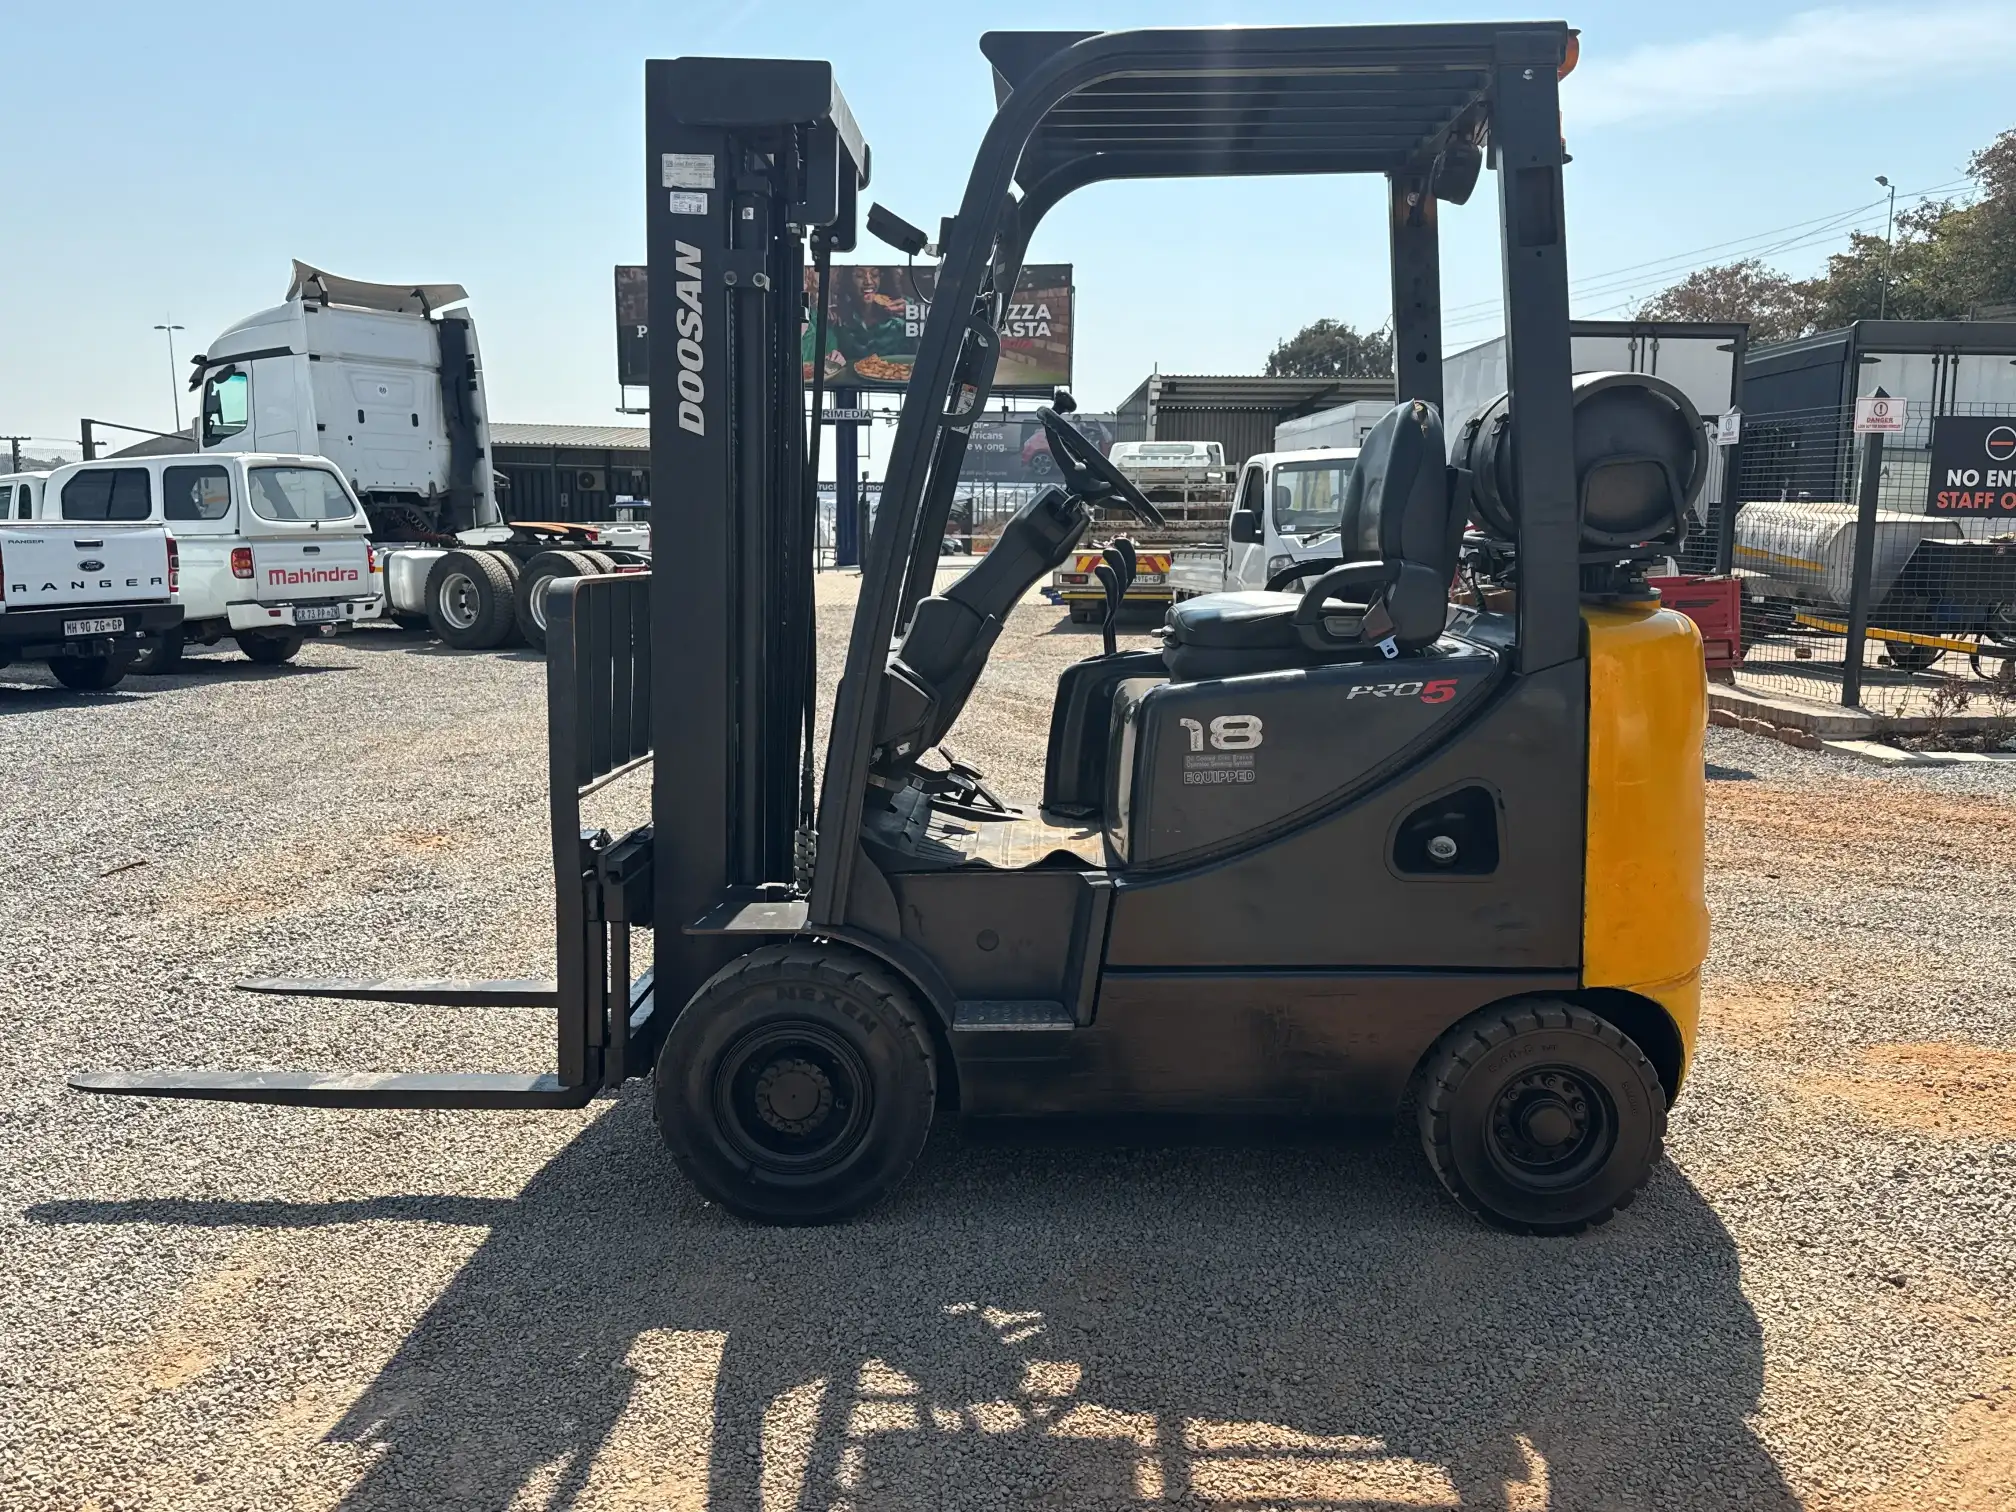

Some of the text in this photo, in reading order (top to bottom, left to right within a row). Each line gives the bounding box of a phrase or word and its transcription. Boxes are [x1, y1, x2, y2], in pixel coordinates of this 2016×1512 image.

[905, 304, 1052, 321] BI ZZA
[675, 240, 705, 436] DOOSAN
[1947, 469, 1980, 487] NO
[1936, 491, 1996, 509] STAFF
[12, 577, 162, 593] RANGER
[268, 567, 358, 585] Mahindra
[80, 621, 91, 633] 90
[94, 620, 105, 632] ZG
[112, 619, 123, 631] GP
[1179, 714, 1263, 752] 18
[1183, 769, 1256, 785] EQUIPPED
[776, 986, 878, 1035] NEXEN
